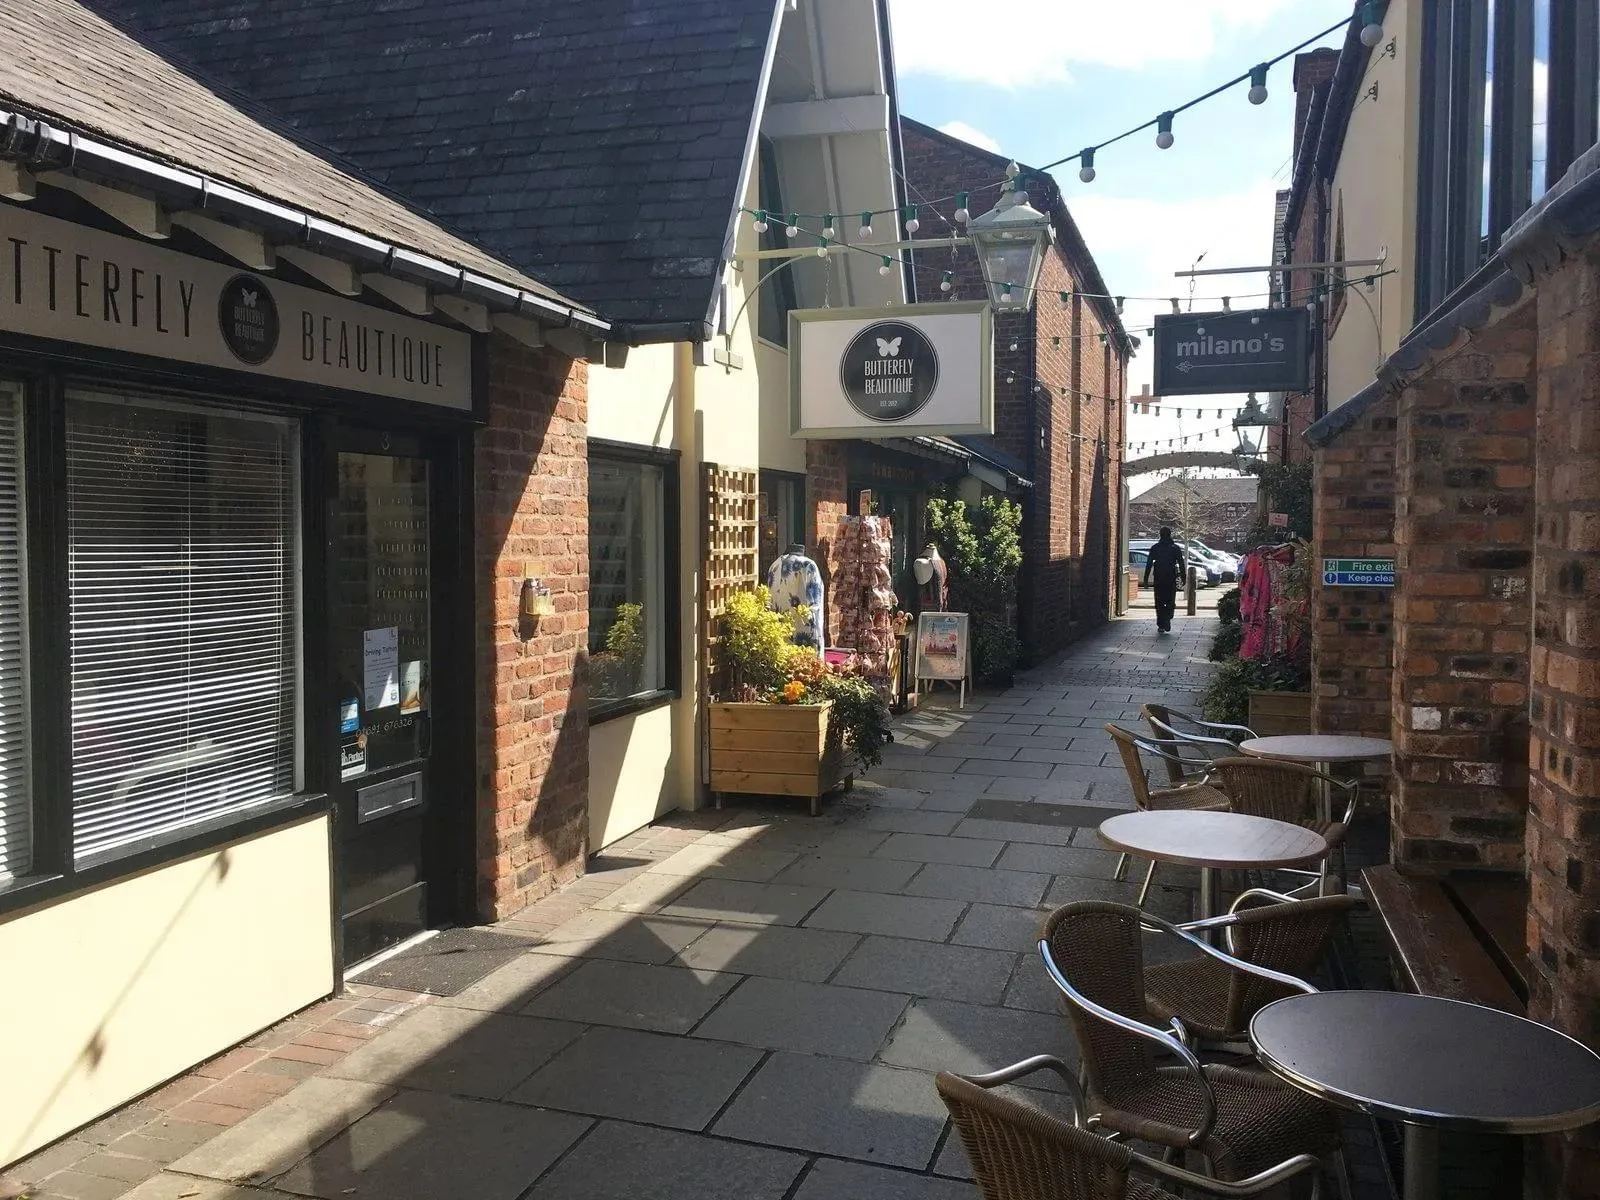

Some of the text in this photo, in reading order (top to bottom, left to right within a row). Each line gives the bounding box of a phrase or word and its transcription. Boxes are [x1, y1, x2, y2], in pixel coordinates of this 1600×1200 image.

[8, 236, 442, 388] TTERFLY BEAUTIQUE
[1176, 332, 1285, 357] milano's
[864, 358, 914, 376] BUTTERFLY
[864, 377, 914, 395] BEAUTIQUE
[380, 431, 390, 450] 3
[1352, 562, 1394, 571] Fire exit
[1348, 573, 1373, 583] Keep
